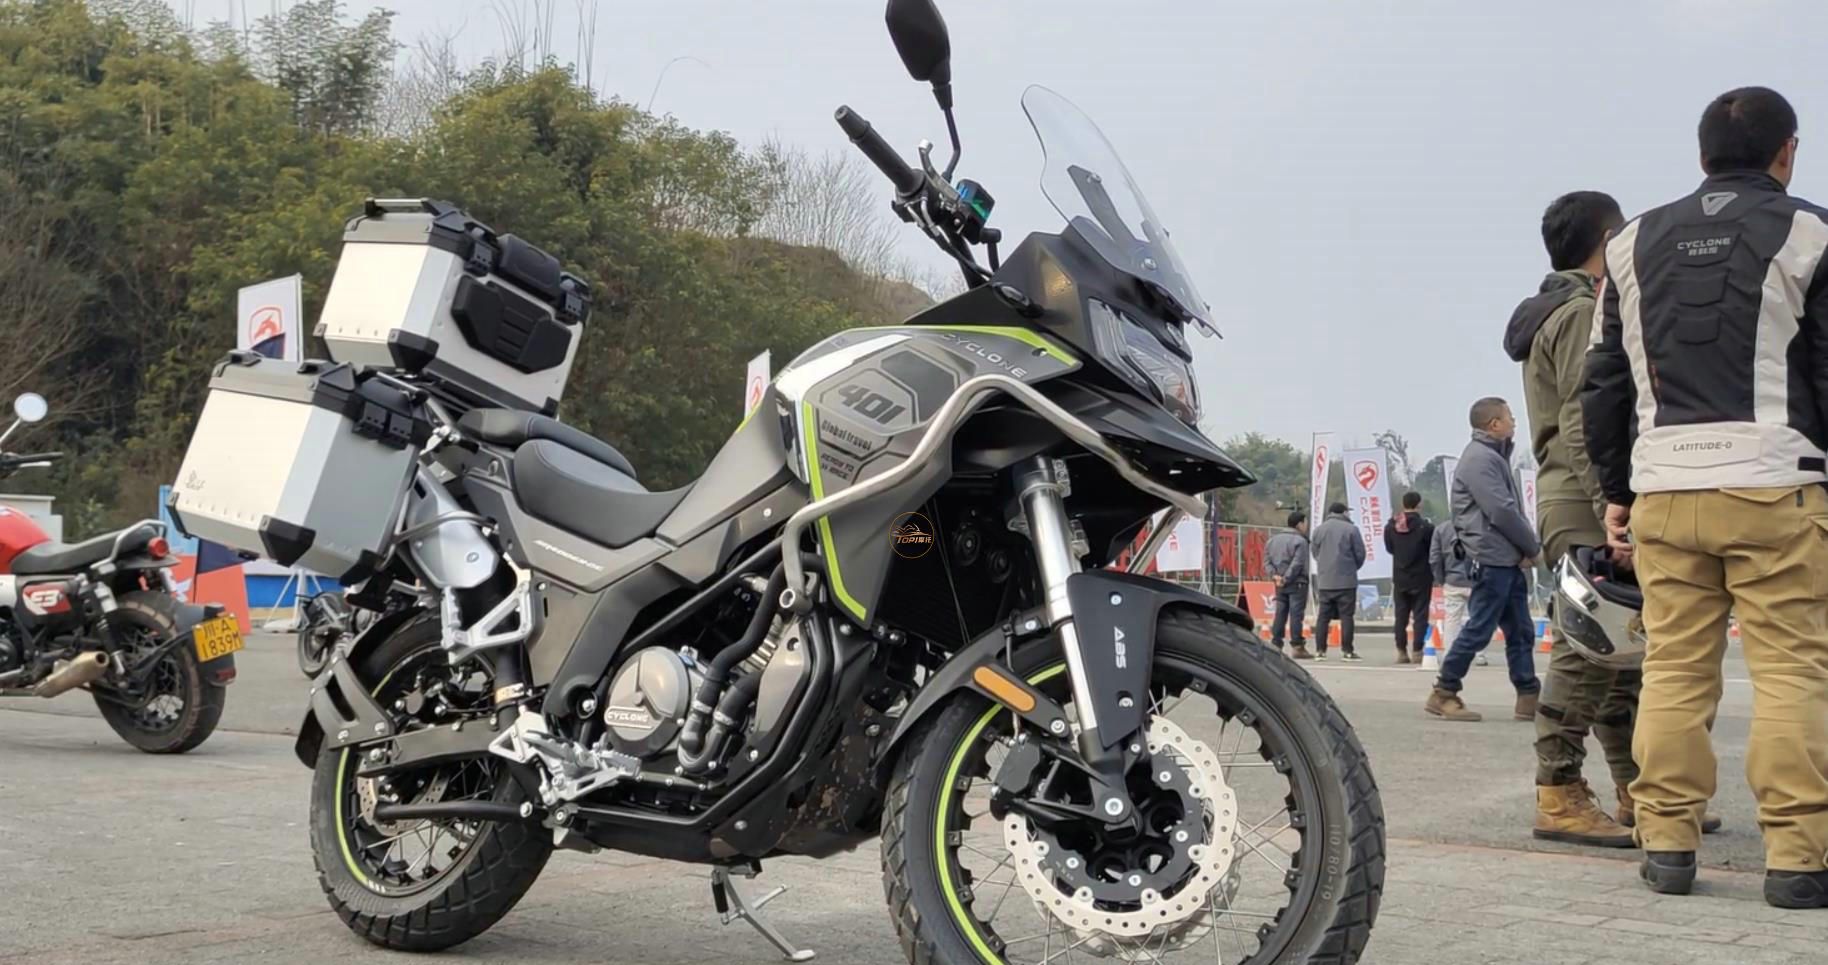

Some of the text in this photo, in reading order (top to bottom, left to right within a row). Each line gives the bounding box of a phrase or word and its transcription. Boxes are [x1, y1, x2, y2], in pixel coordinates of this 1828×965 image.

[1677, 237, 1731, 250] CYCLONE
[941, 333, 1028, 378] CYCLONE
[821, 419, 872, 451] Global travel
[1360, 496, 1375, 561] CYCLONE
[201, 631, 242, 658] 1839M
[1113, 626, 1127, 669] ABS
[607, 711, 649, 723] CYCLONE
